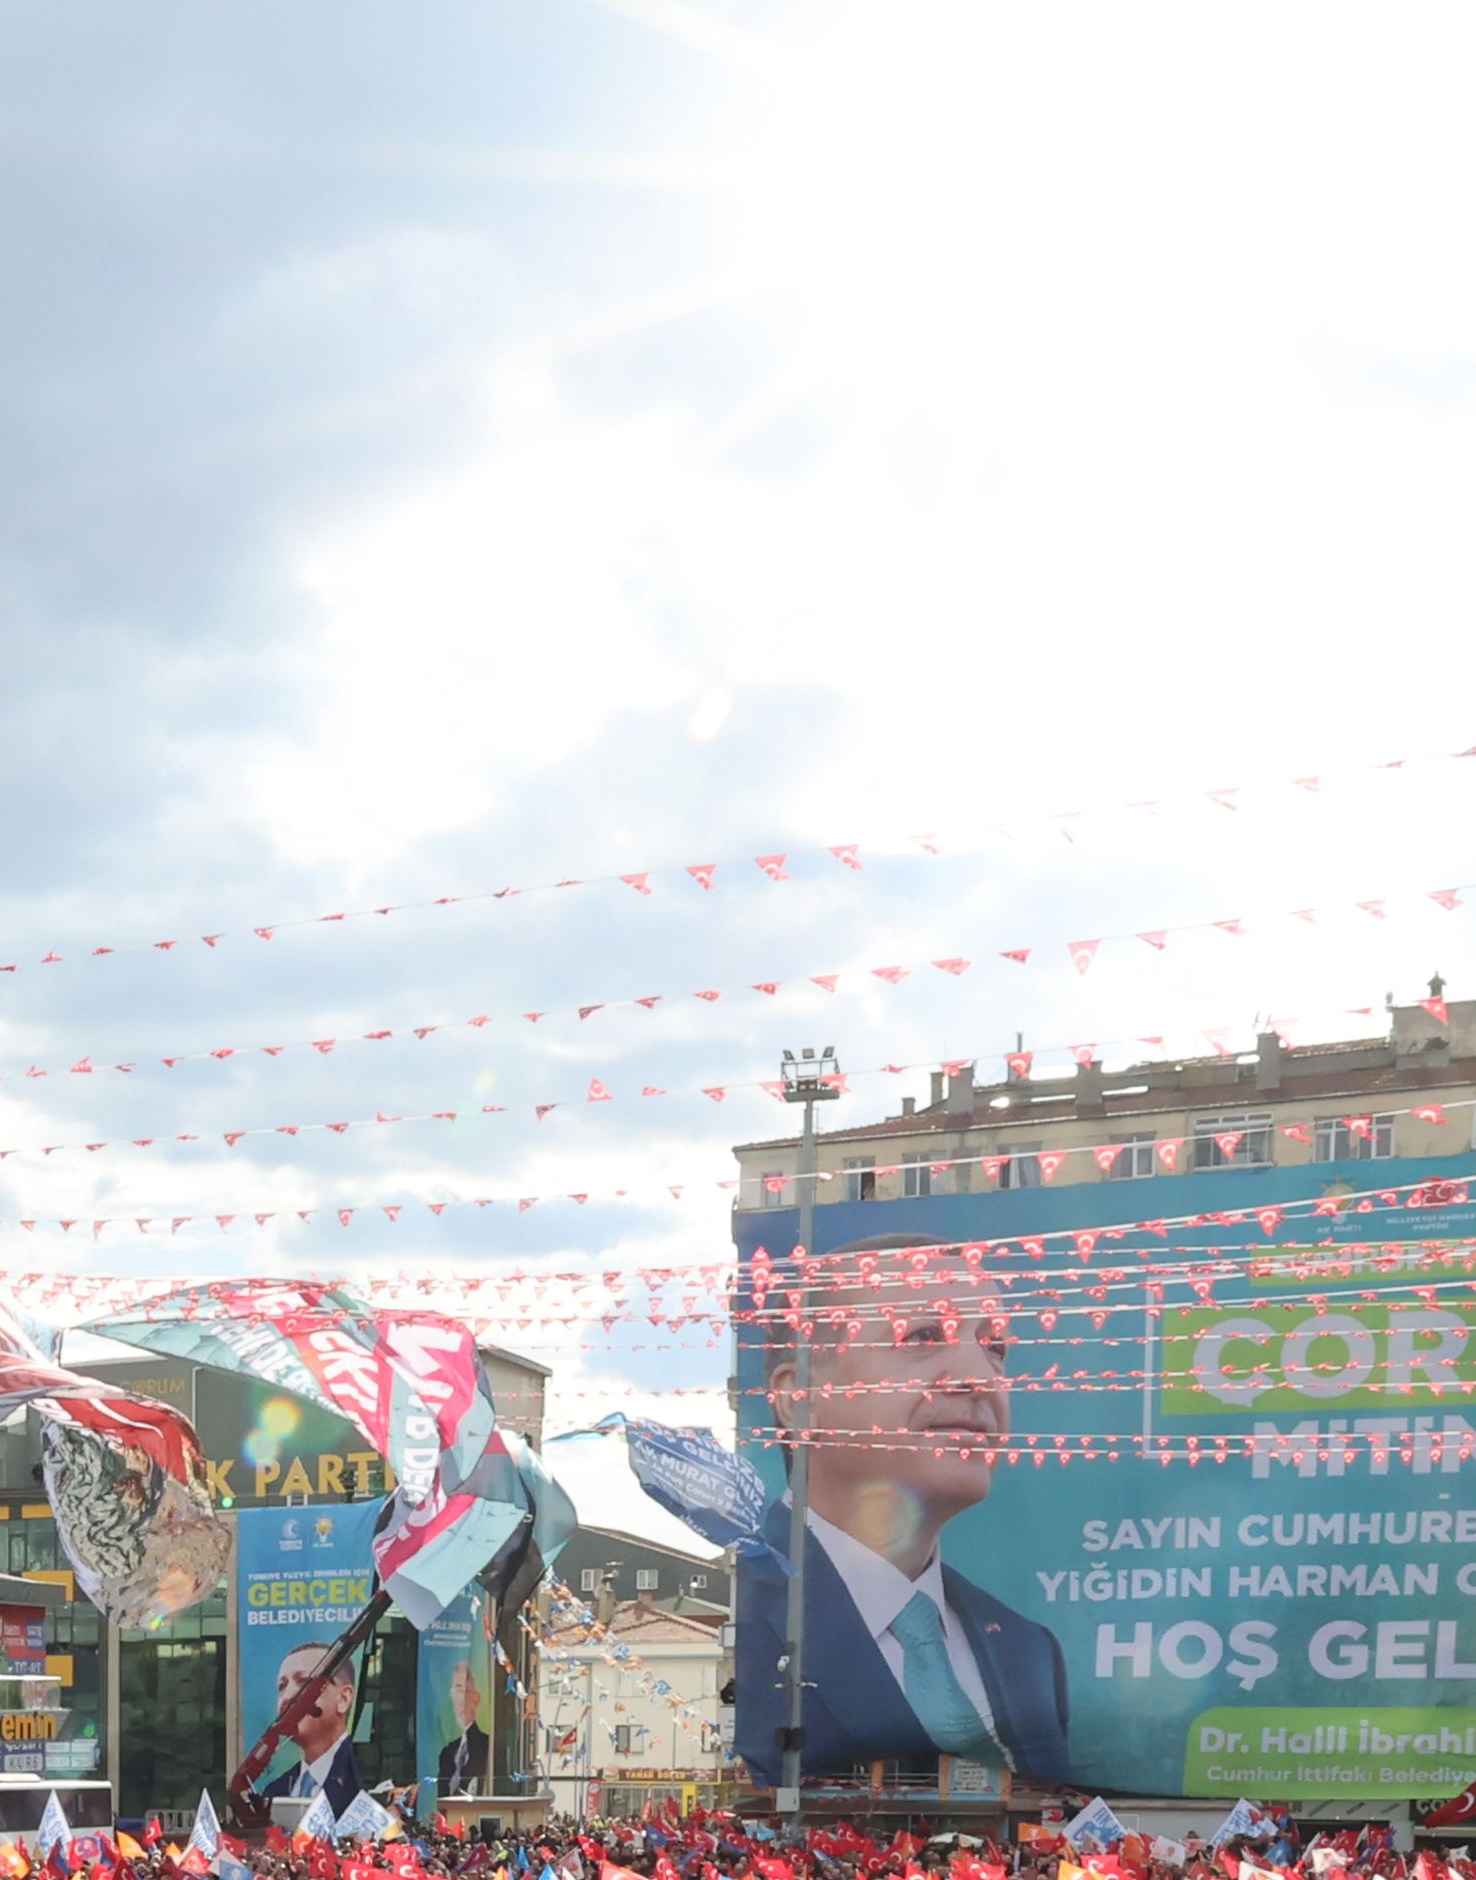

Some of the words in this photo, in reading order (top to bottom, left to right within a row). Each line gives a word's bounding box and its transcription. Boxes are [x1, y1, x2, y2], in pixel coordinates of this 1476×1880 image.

[660, 1454, 720, 1491] MURAT
[1081, 1515, 1221, 1552] SAYIN
[248, 1578, 369, 1607] GERÇEK
[1036, 1561, 1212, 1602] YİĞİDİN
[1228, 1562, 1439, 1598] HARMAN
[247, 1607, 368, 1626] BELEDİYECİLİ
[1095, 1618, 1279, 1692] HOŞ
[1200, 1726, 1249, 1754] Dr.
[1261, 1724, 1347, 1755] Halil
[1206, 1764, 1293, 1782] Cumhur
